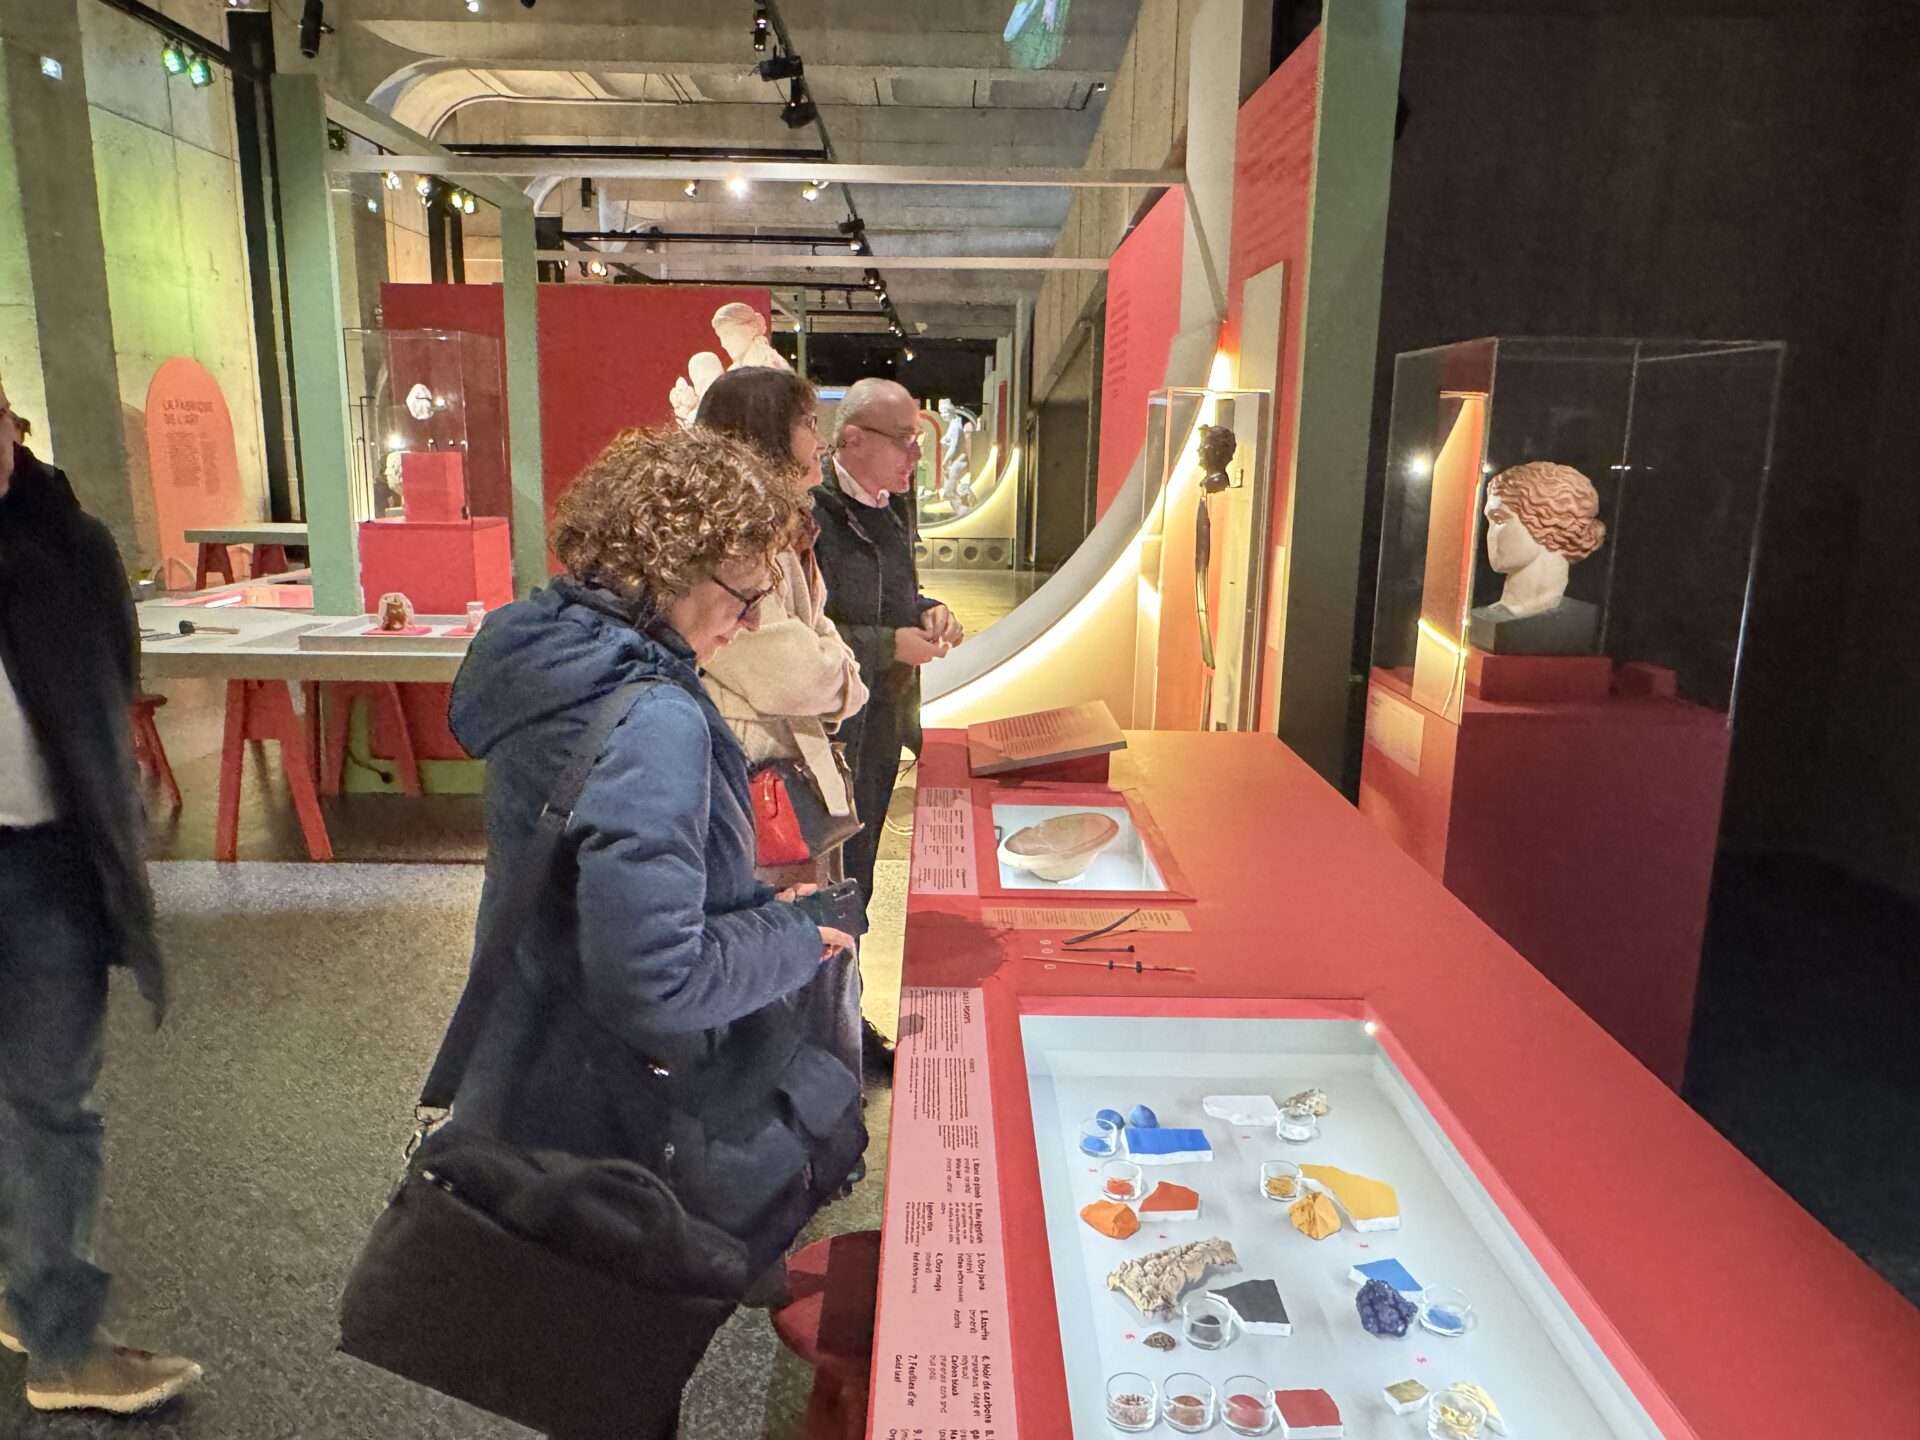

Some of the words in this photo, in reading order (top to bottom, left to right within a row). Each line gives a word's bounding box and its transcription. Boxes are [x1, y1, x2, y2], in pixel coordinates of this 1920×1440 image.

[982, 1364, 992, 1379] Noir
[983, 1381, 993, 1390] de
[983, 1392, 993, 1423] carbone
